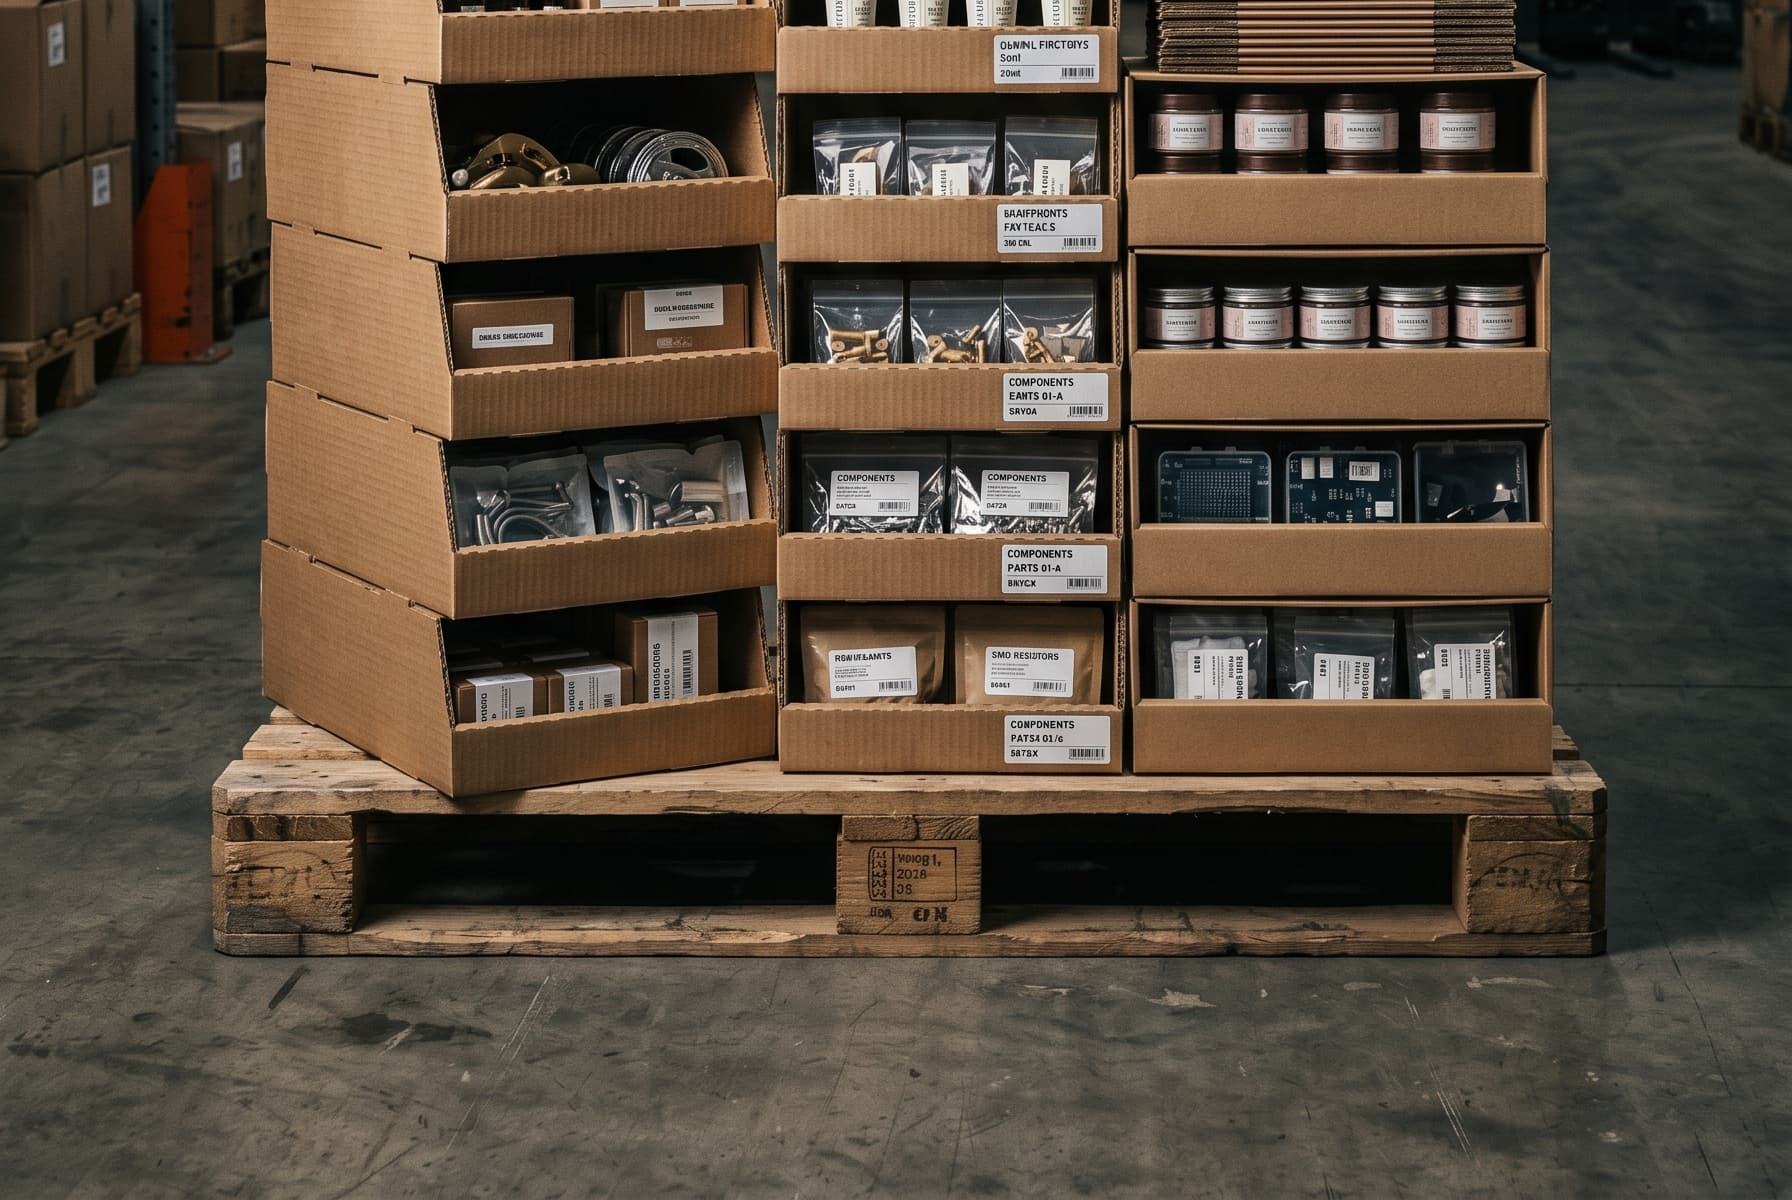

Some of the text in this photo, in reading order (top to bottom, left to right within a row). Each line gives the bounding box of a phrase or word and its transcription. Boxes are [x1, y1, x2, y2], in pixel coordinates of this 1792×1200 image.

[1009, 377, 1074, 387] COMPONENTS
[837, 474, 895, 482] COMPONENTS
[987, 473, 1047, 482] COMPONENTS
[1007, 549, 1073, 558] COMPONENTS
[1007, 563, 1061, 572] PARTS 01-A
[991, 651, 1011, 659] SMD
